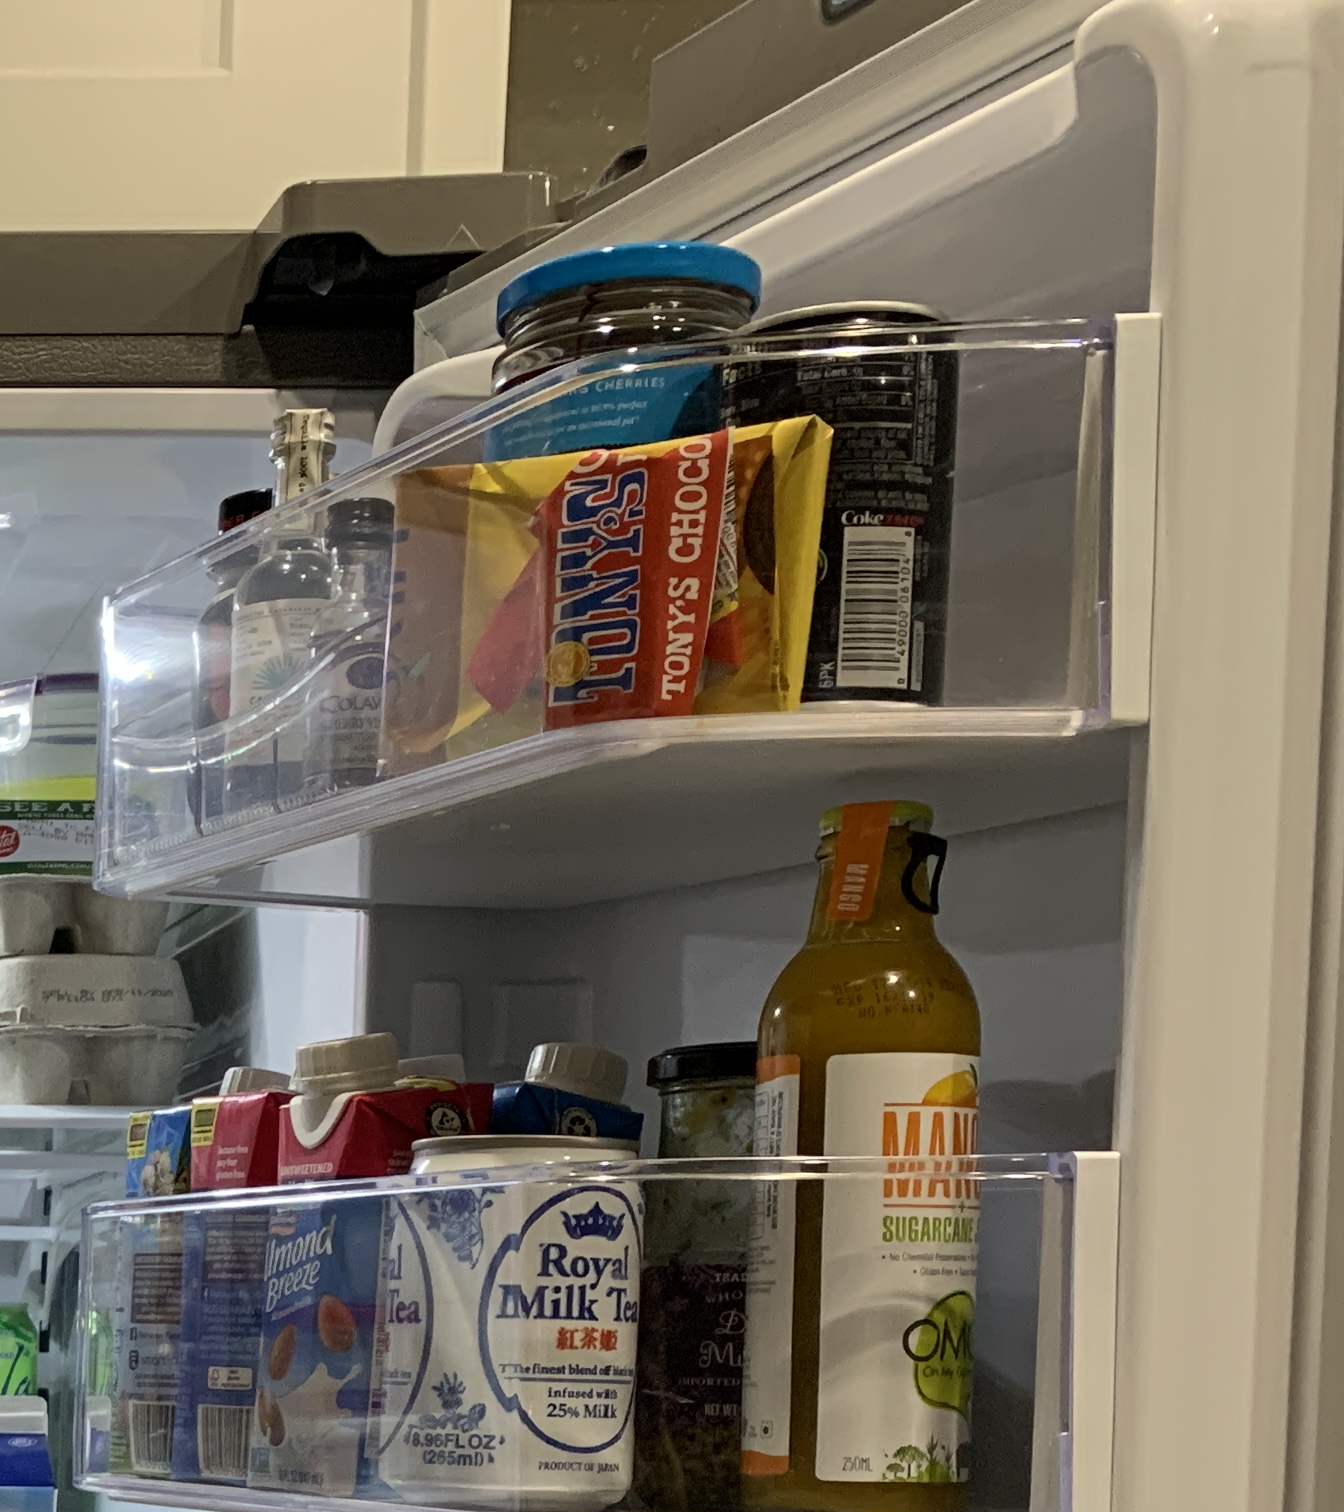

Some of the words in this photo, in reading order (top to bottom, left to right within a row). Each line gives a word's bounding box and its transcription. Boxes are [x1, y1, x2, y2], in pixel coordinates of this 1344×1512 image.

[595, 376, 665, 392] CHERRIES
[840, 511, 883, 526] Coke
[548, 467, 649, 708] TONY'S
[662, 577, 699, 701] TONY'S
[56, 802, 74, 813] A
[845, 863, 866, 914] MANGO
[881, 1215, 974, 1244] SUGARCANE
[537, 1243, 629, 1288] Royal
[265, 1263, 321, 1312] Breeze
[502, 1284, 599, 1321] Milk
[605, 1286, 638, 1323] Tea
[532, 1362, 565, 1375] finest
[567, 1364, 597, 1377] blend
[547, 1387, 592, 1400] infused
[595, 1388, 618, 1400] with
[546, 1403, 580, 1420] 25%
[583, 1404, 618, 1420] Milk
[538, 1461, 582, 1472] PRODUCT
[583, 1462, 595, 1472] OF
[597, 1462, 620, 1473] JAPAN
[842, 1457, 873, 1472] 250ML
